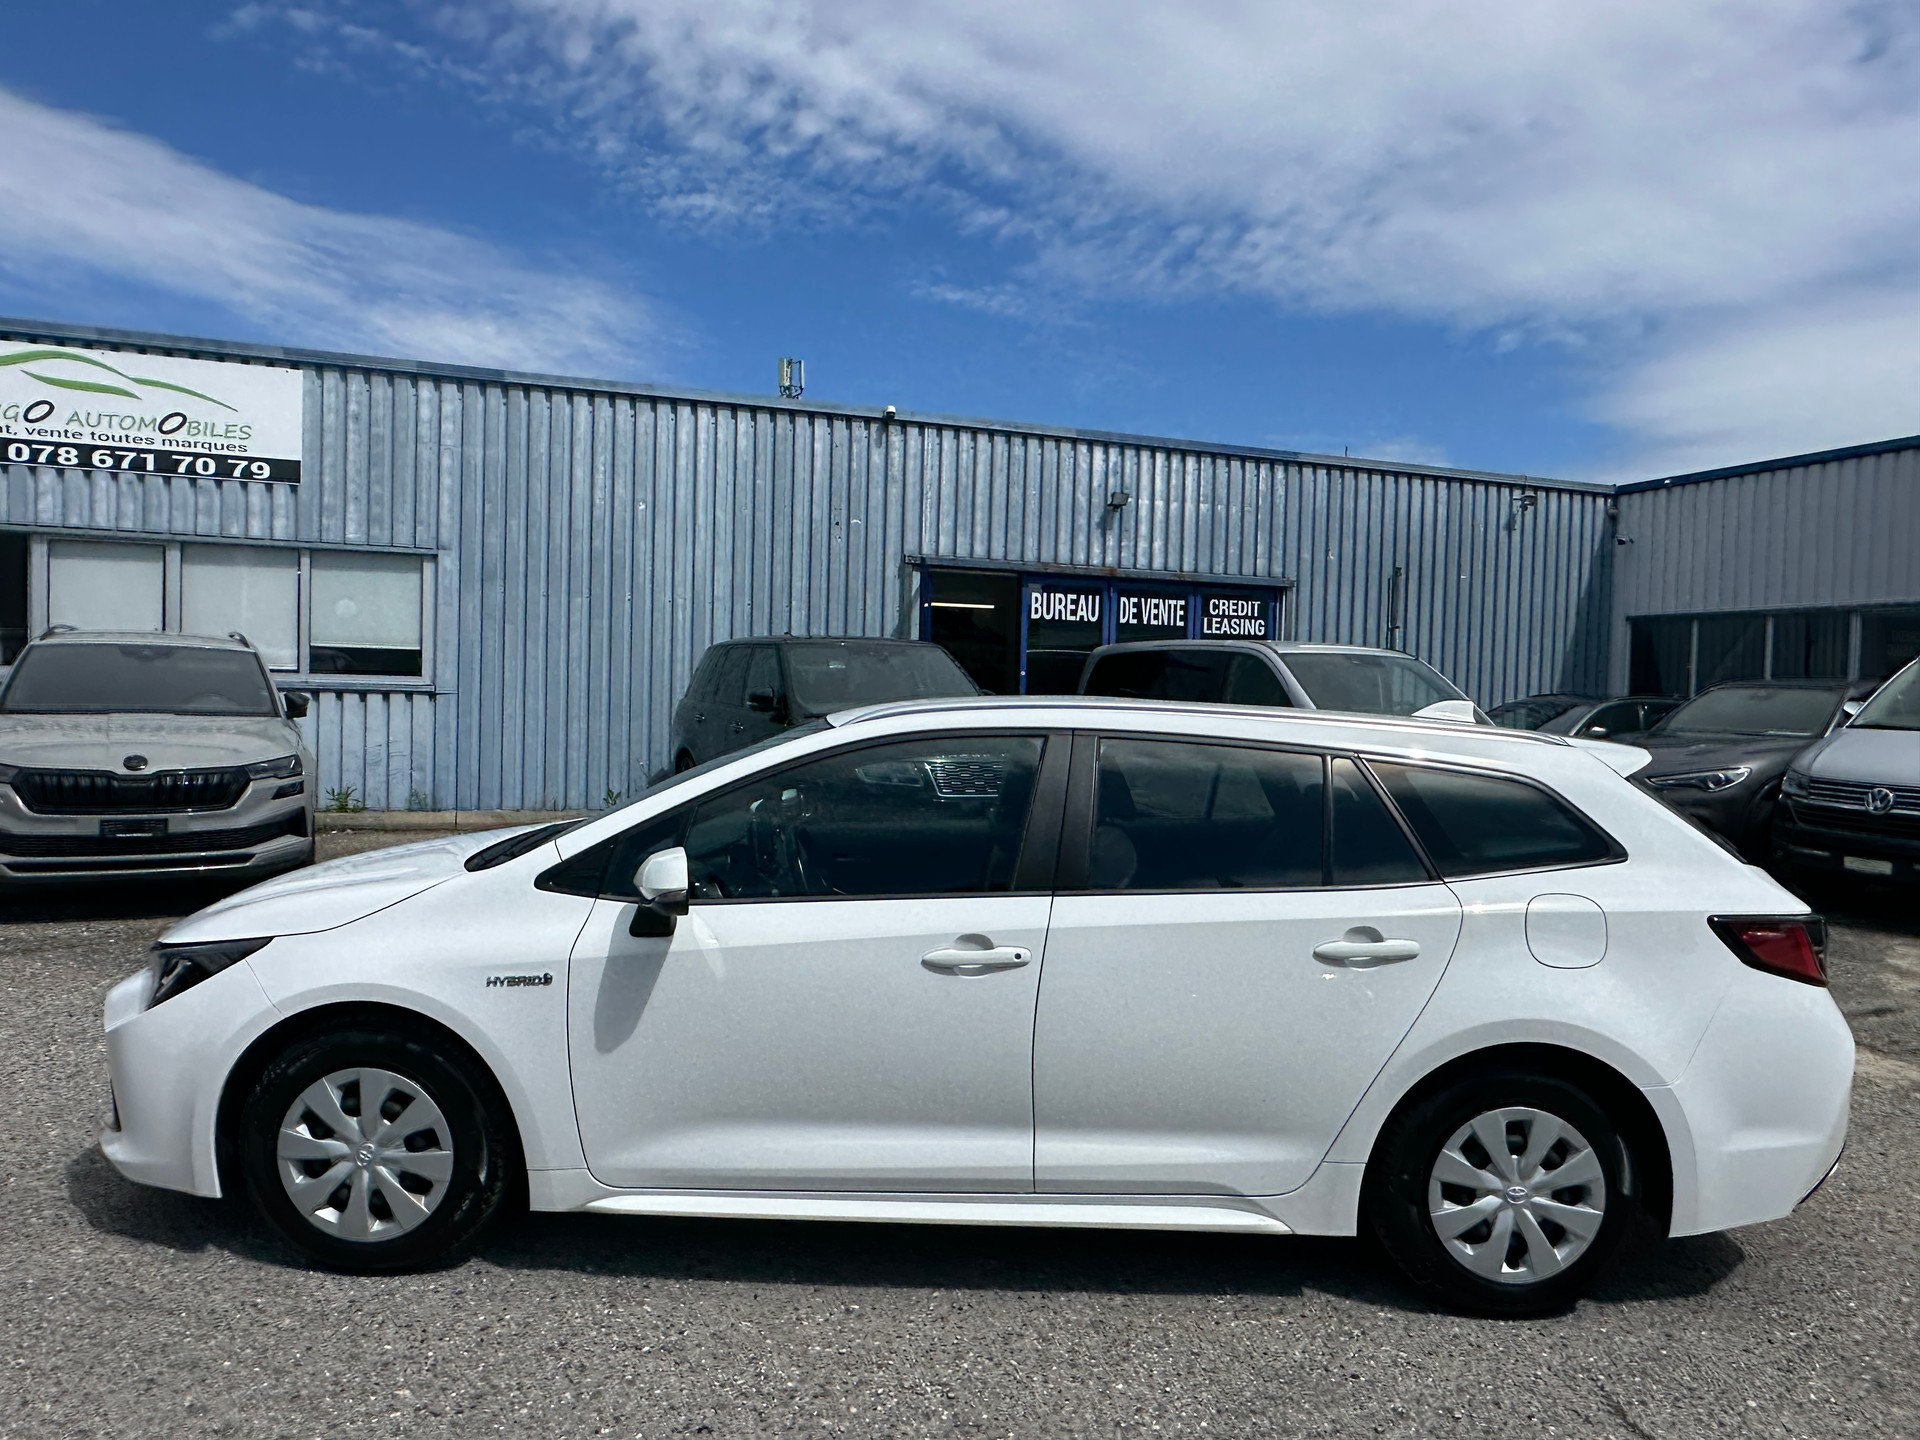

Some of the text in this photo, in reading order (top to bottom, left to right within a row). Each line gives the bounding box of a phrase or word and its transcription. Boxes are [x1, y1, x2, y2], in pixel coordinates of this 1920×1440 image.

[0, 400, 252, 441] GO AUTOMOBILES
[25, 426, 83, 440] vente
[91, 431, 155, 445] toutes
[162, 437, 248, 453] marques
[8, 443, 271, 480] 078 671 70 79
[1031, 592, 1185, 626] BUREAU DE VENTE
[1209, 599, 1261, 617] CREDIT
[1203, 617, 1265, 636] LEASING
[486, 975, 542, 988] HYBRID
